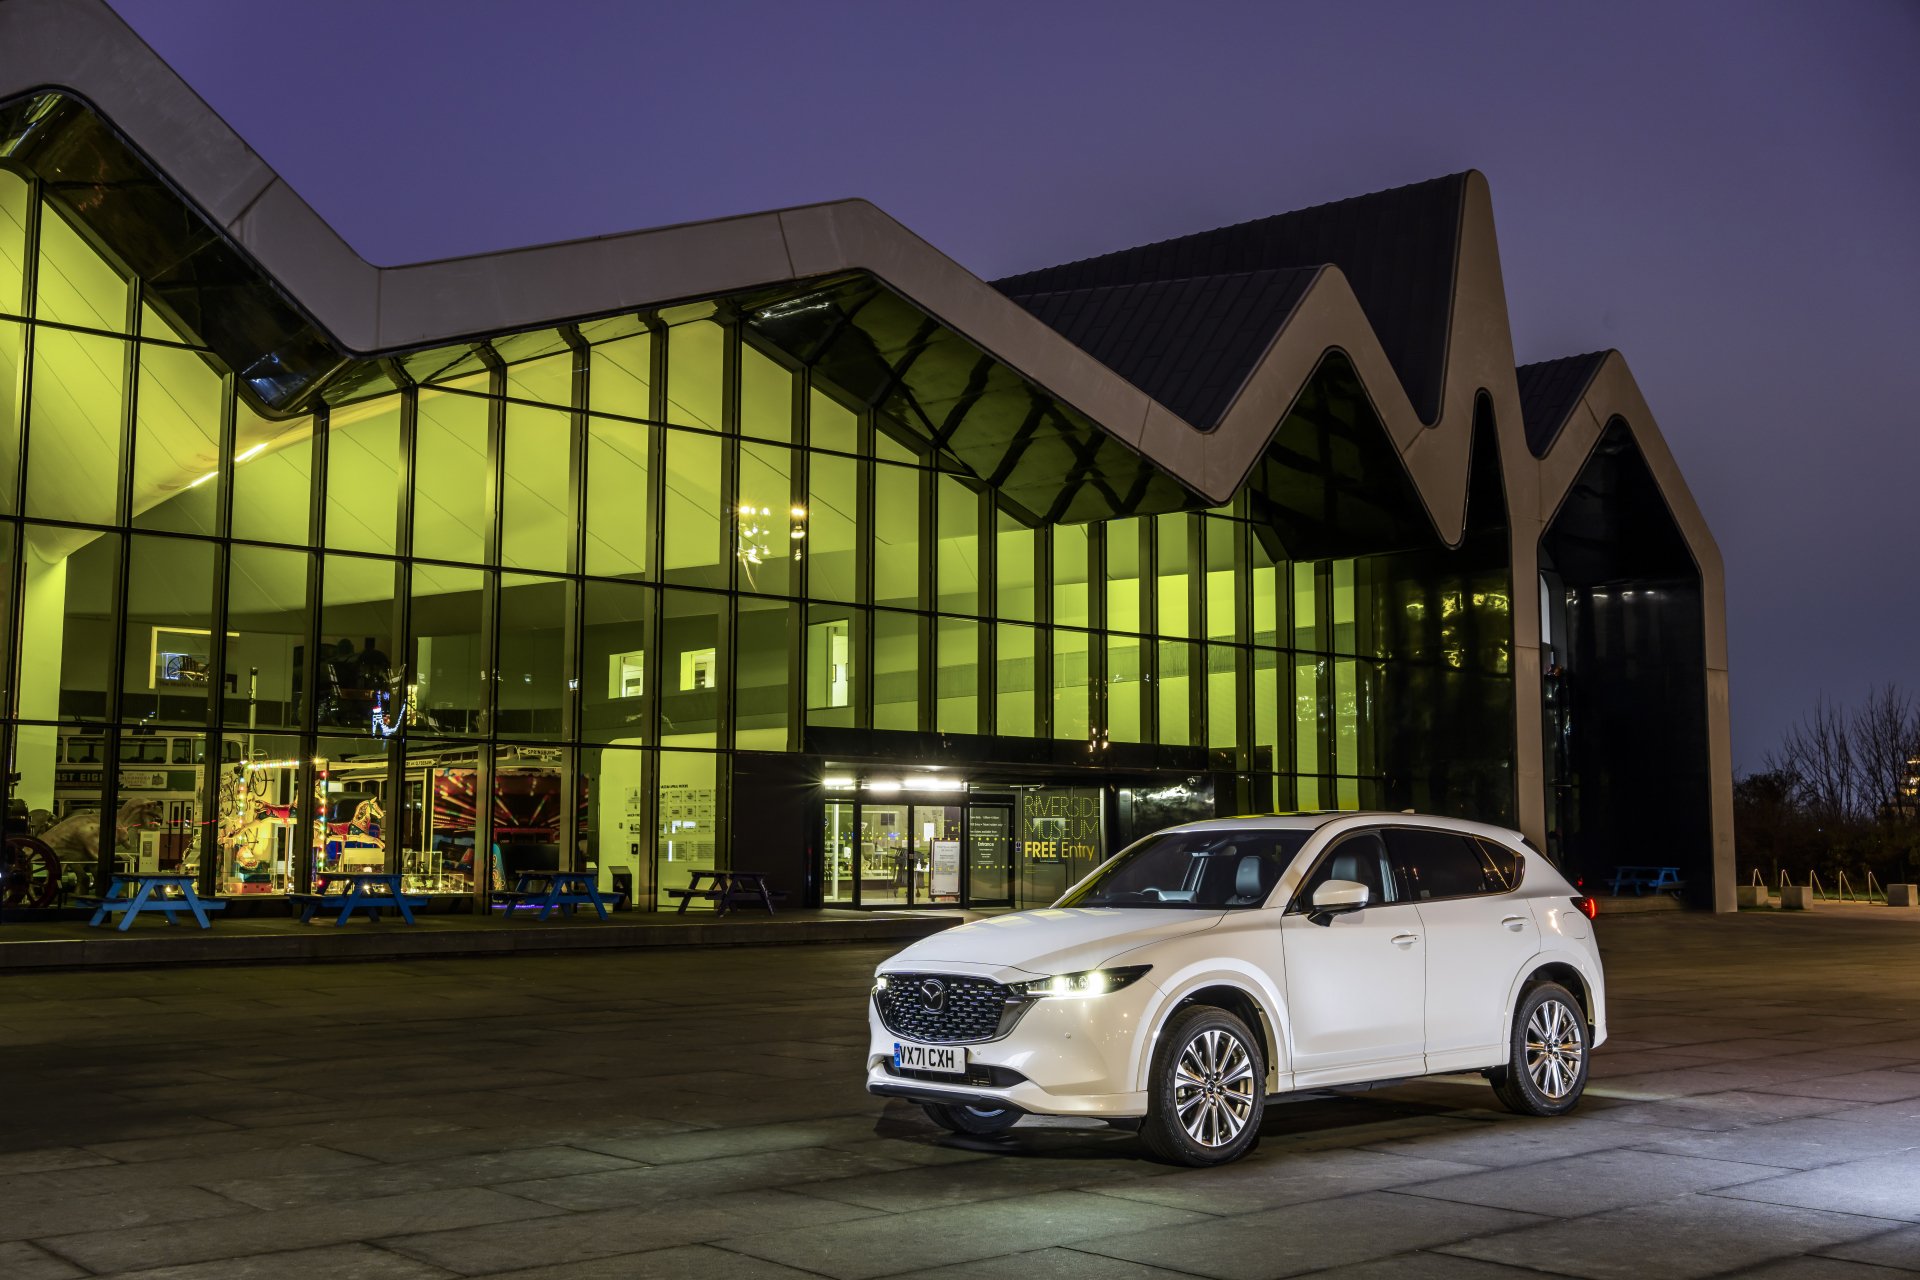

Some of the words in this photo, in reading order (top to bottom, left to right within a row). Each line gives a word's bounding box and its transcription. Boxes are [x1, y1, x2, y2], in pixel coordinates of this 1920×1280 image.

[1025, 795, 1101, 818] RIVERSIDE
[1025, 818, 1099, 840] MUSEUM
[1025, 841, 1056, 858] FREE
[1061, 841, 1095, 862] Entry
[899, 1045, 925, 1066] VX71
[928, 1048, 954, 1068] CXH
